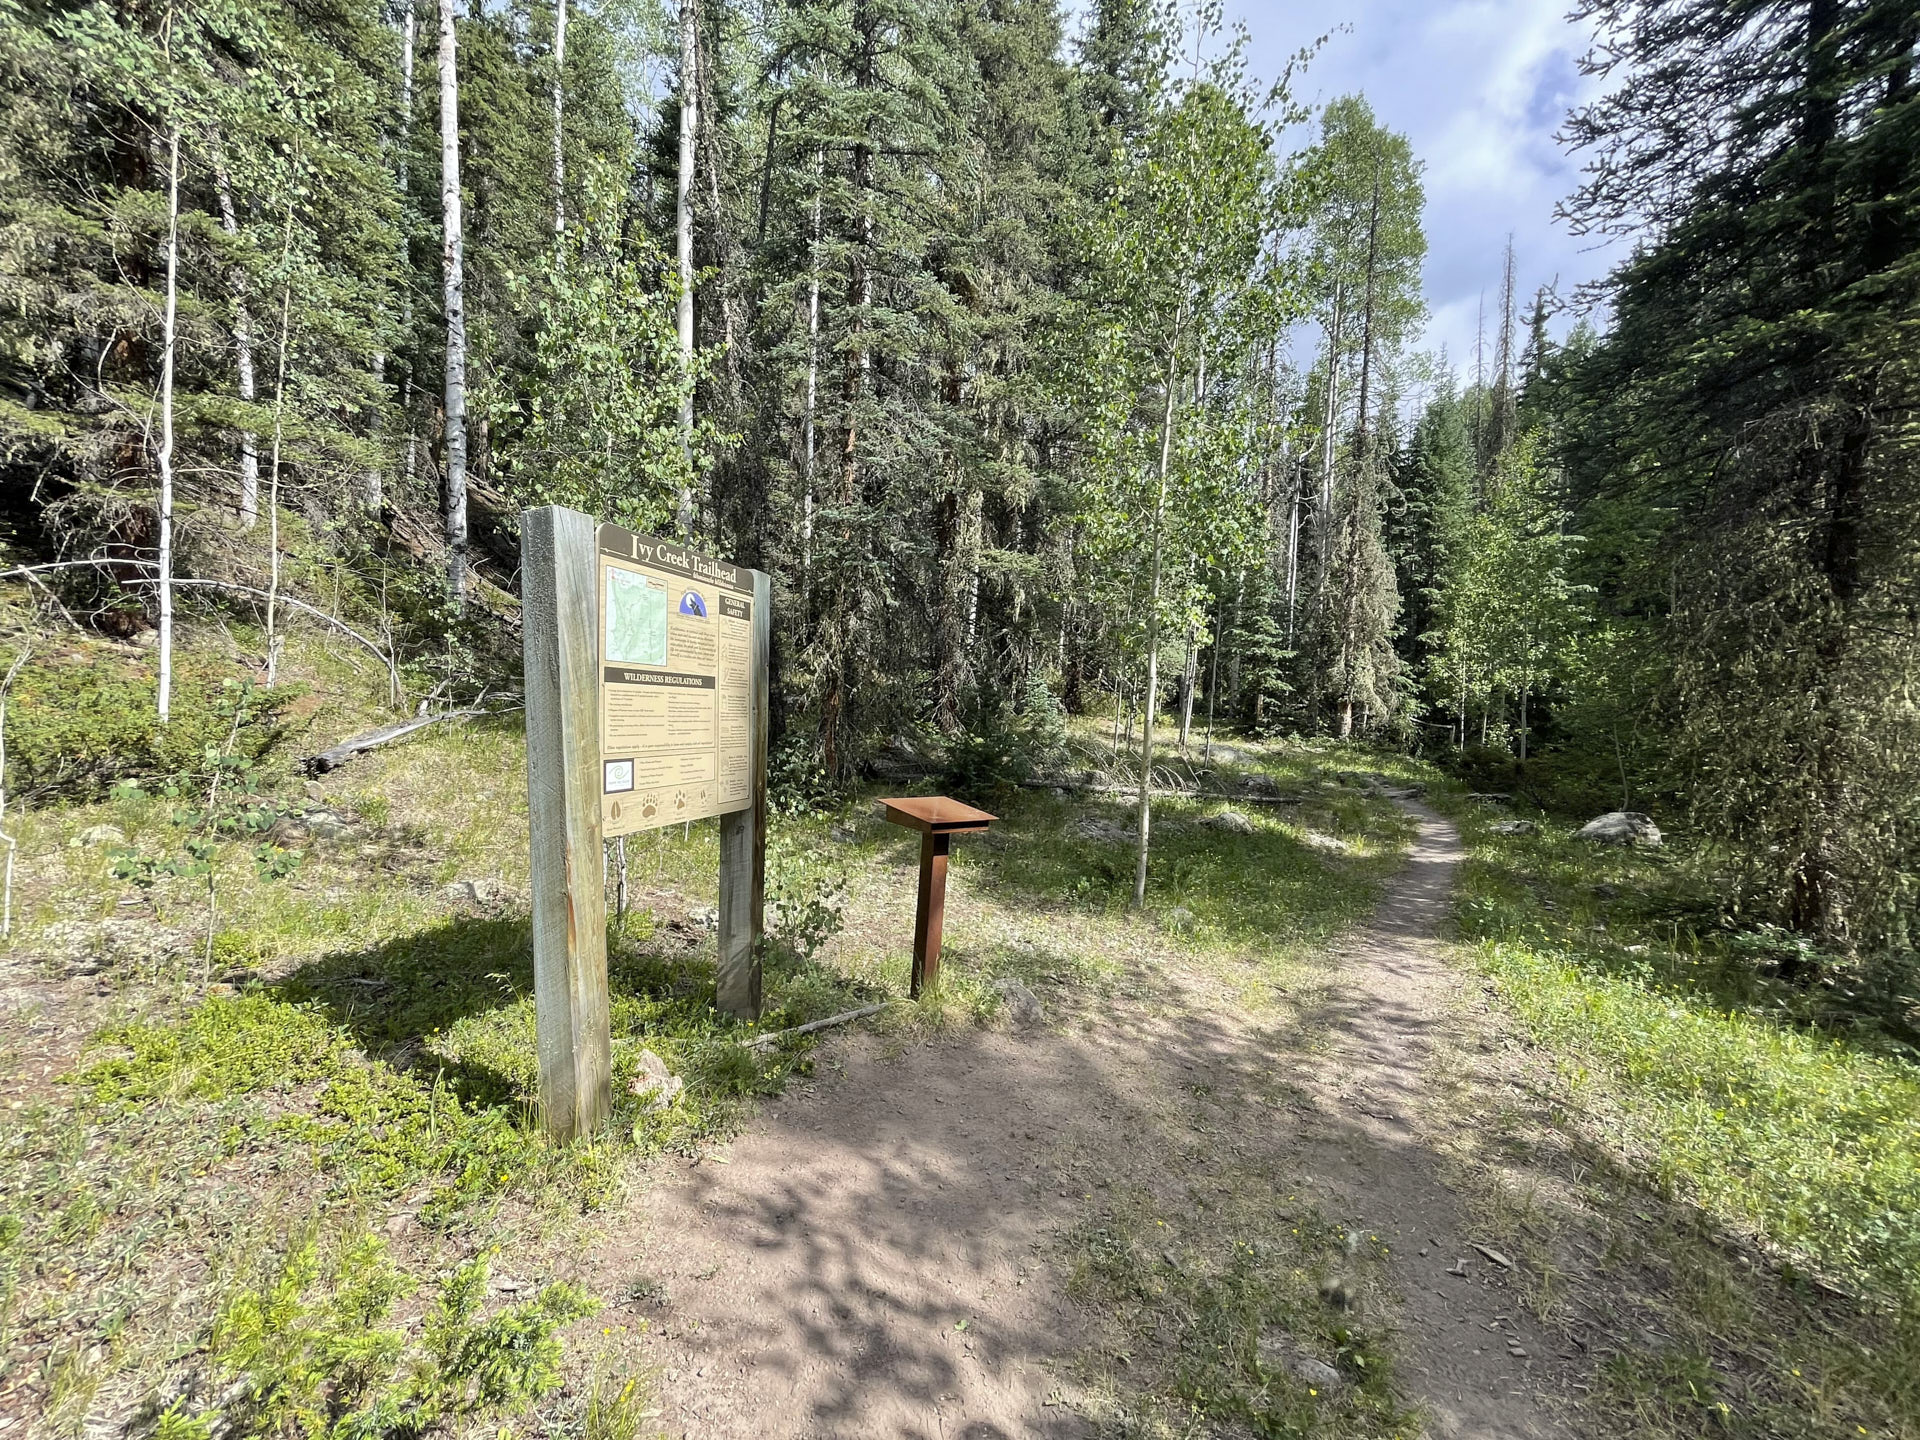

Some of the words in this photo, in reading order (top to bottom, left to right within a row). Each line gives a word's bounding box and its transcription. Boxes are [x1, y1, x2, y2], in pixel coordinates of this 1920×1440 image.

[631, 534, 654, 562] Ivy
[656, 544, 690, 569] Creek
[692, 555, 736, 583] Trailhead
[725, 597, 745, 608] GENERAL
[726, 607, 743, 618] SAFETY
[624, 672, 664, 683] WILDERNESS
[665, 675, 702, 686] REGULATIONS
